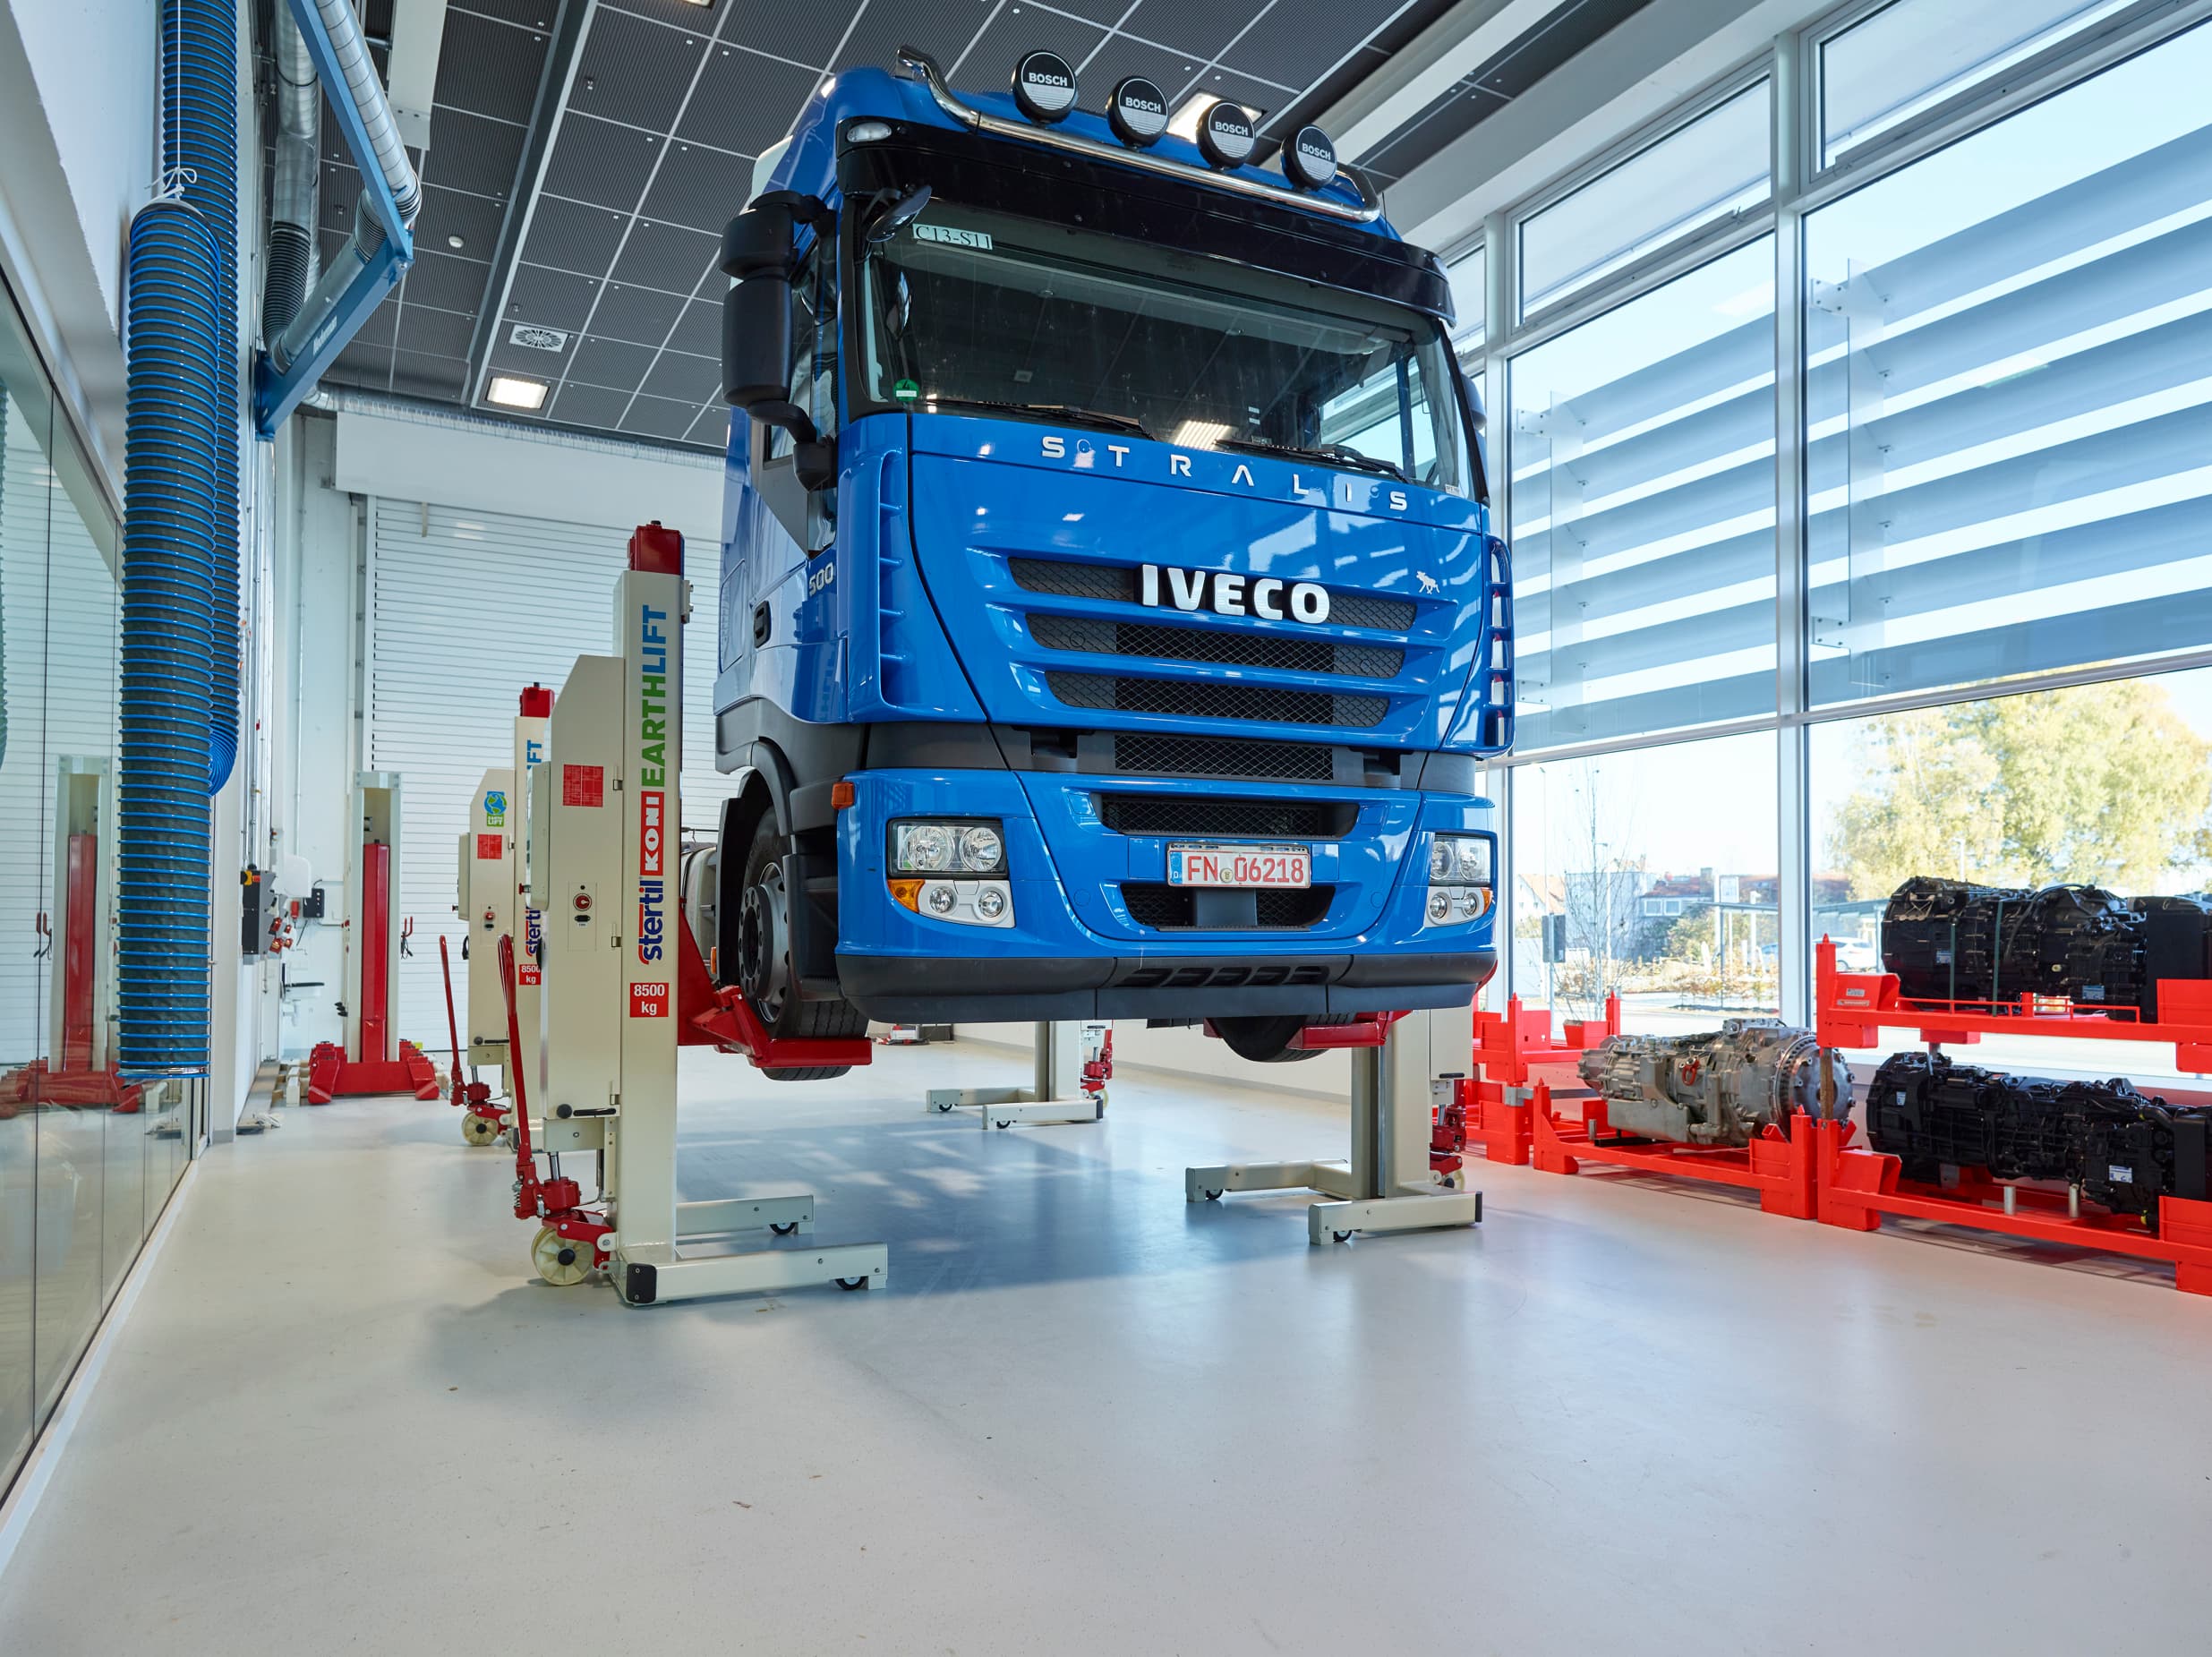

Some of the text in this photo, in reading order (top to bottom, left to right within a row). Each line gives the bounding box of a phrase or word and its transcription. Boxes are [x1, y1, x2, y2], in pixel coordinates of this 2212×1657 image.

[1029, 72, 1068, 87] BOSCH
[1125, 97, 1161, 114] BOSCH
[1215, 121, 1249, 137] BOSCH
[1302, 142, 1331, 160] BOSCH
[915, 226, 990, 249] C13-S11
[1041, 436, 1408, 510] STRALIS
[808, 562, 834, 597] 500
[1141, 564, 1330, 624] IVECO
[638, 604, 667, 965] stertil KONI EARTHLIFT
[1187, 855, 1218, 882] FN
[1234, 857, 1304, 884] 06218
[525, 906, 542, 957] sterti
[525, 974, 537, 985] kg
[634, 984, 665, 996] 8500
[641, 1001, 657, 1016] kg
